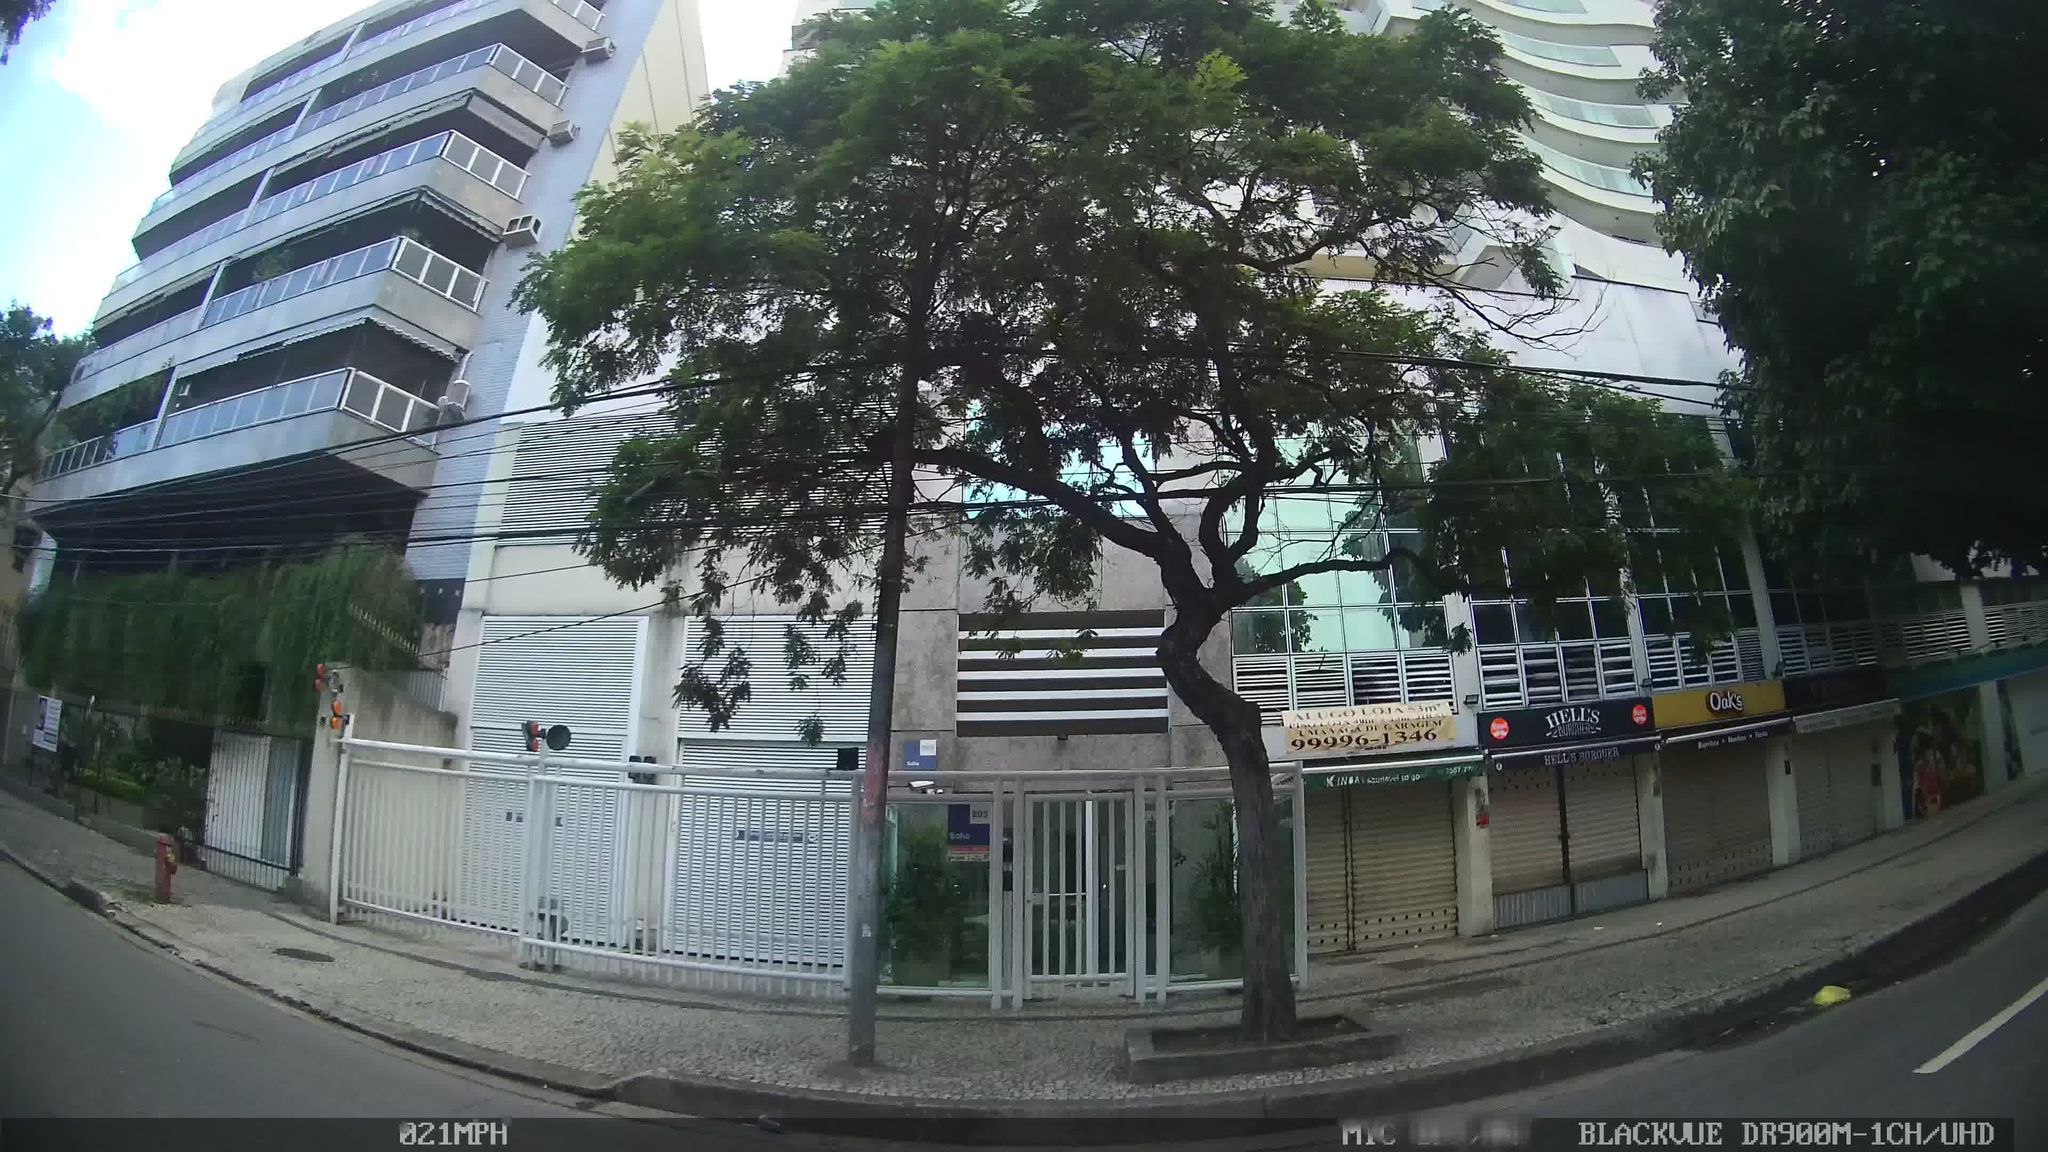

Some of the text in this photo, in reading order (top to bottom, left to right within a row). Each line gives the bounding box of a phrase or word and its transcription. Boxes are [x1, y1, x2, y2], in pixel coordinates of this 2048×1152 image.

[1709, 690, 1744, 711] Oak's
[1295, 708, 1356, 722] ALUGO
[1361, 706, 1404, 718] LOJA
[1545, 706, 1601, 729] HELL'S
[1384, 720, 1443, 731] GARAGEM
[1290, 728, 1438, 751] 99996-1346
[1544, 751, 1577, 766] HELL'S
